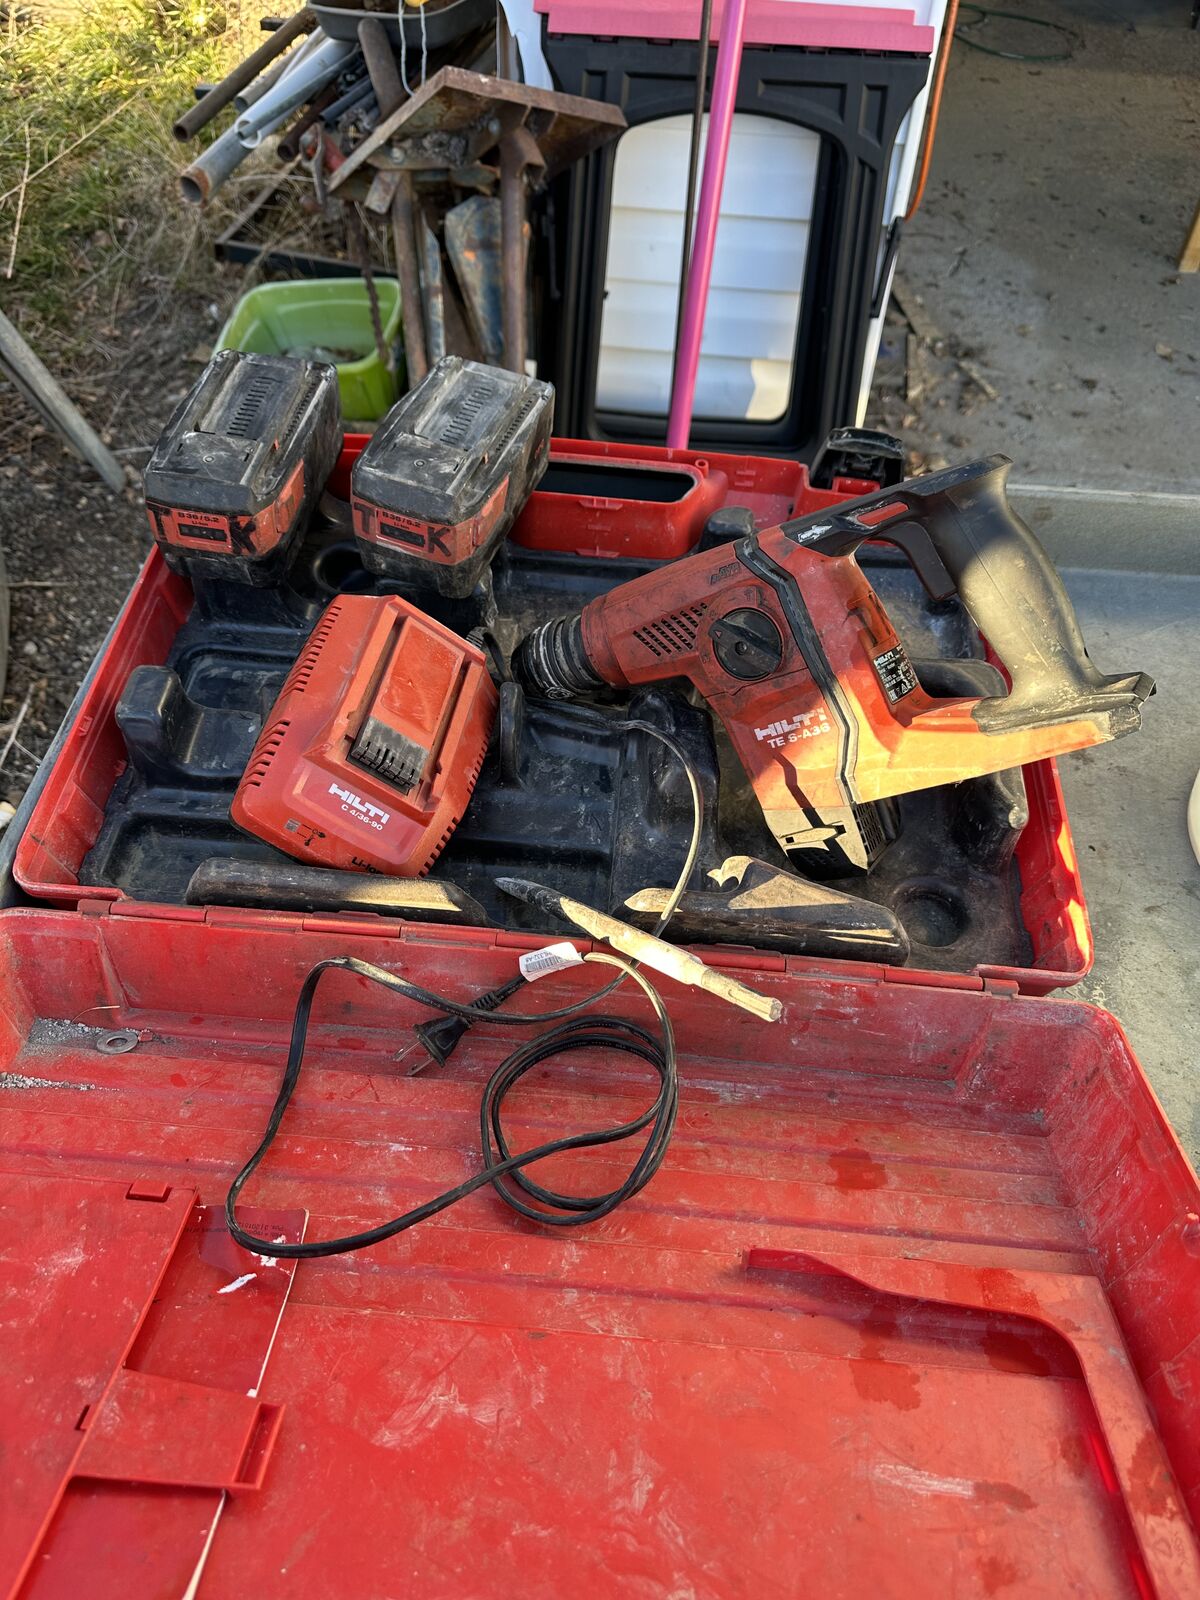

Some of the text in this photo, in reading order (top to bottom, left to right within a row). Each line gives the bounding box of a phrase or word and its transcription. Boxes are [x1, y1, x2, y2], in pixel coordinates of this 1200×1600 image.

[229, 515, 257, 555] K
[354, 502, 452, 557] T K
[754, 707, 827, 741] HILTI
[767, 737, 785, 748] TE
[328, 783, 390, 824] HILTI
[350, 810, 383, 831] 4/36-90
